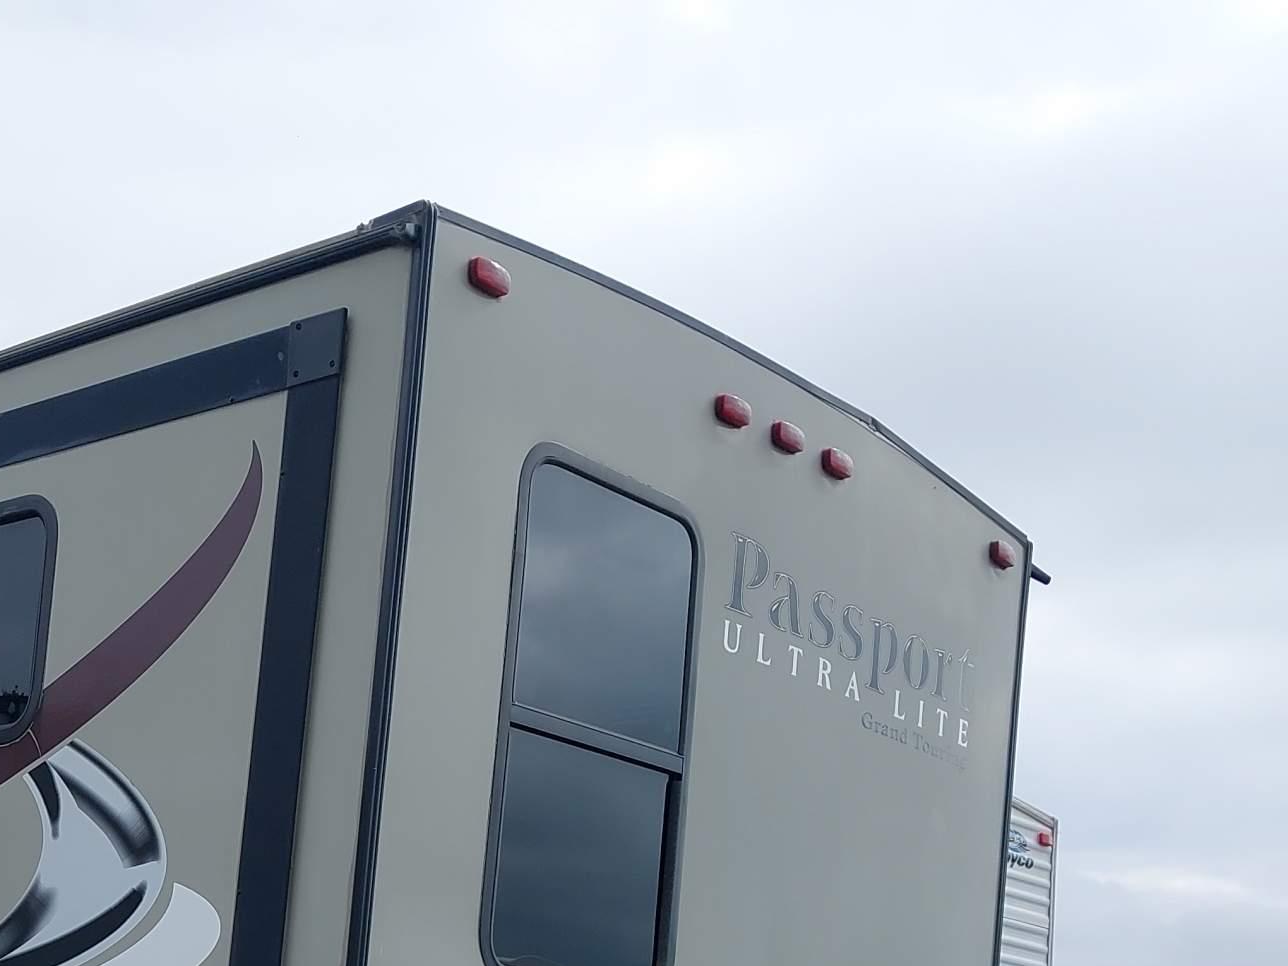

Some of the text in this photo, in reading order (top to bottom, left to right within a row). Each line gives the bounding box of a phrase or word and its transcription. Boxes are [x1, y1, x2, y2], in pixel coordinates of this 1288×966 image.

[725, 530, 975, 712] Passport
[722, 619, 969, 748] ULTRA LITE
[861, 711, 908, 745] Grand
[1008, 853, 1034, 869] yco
